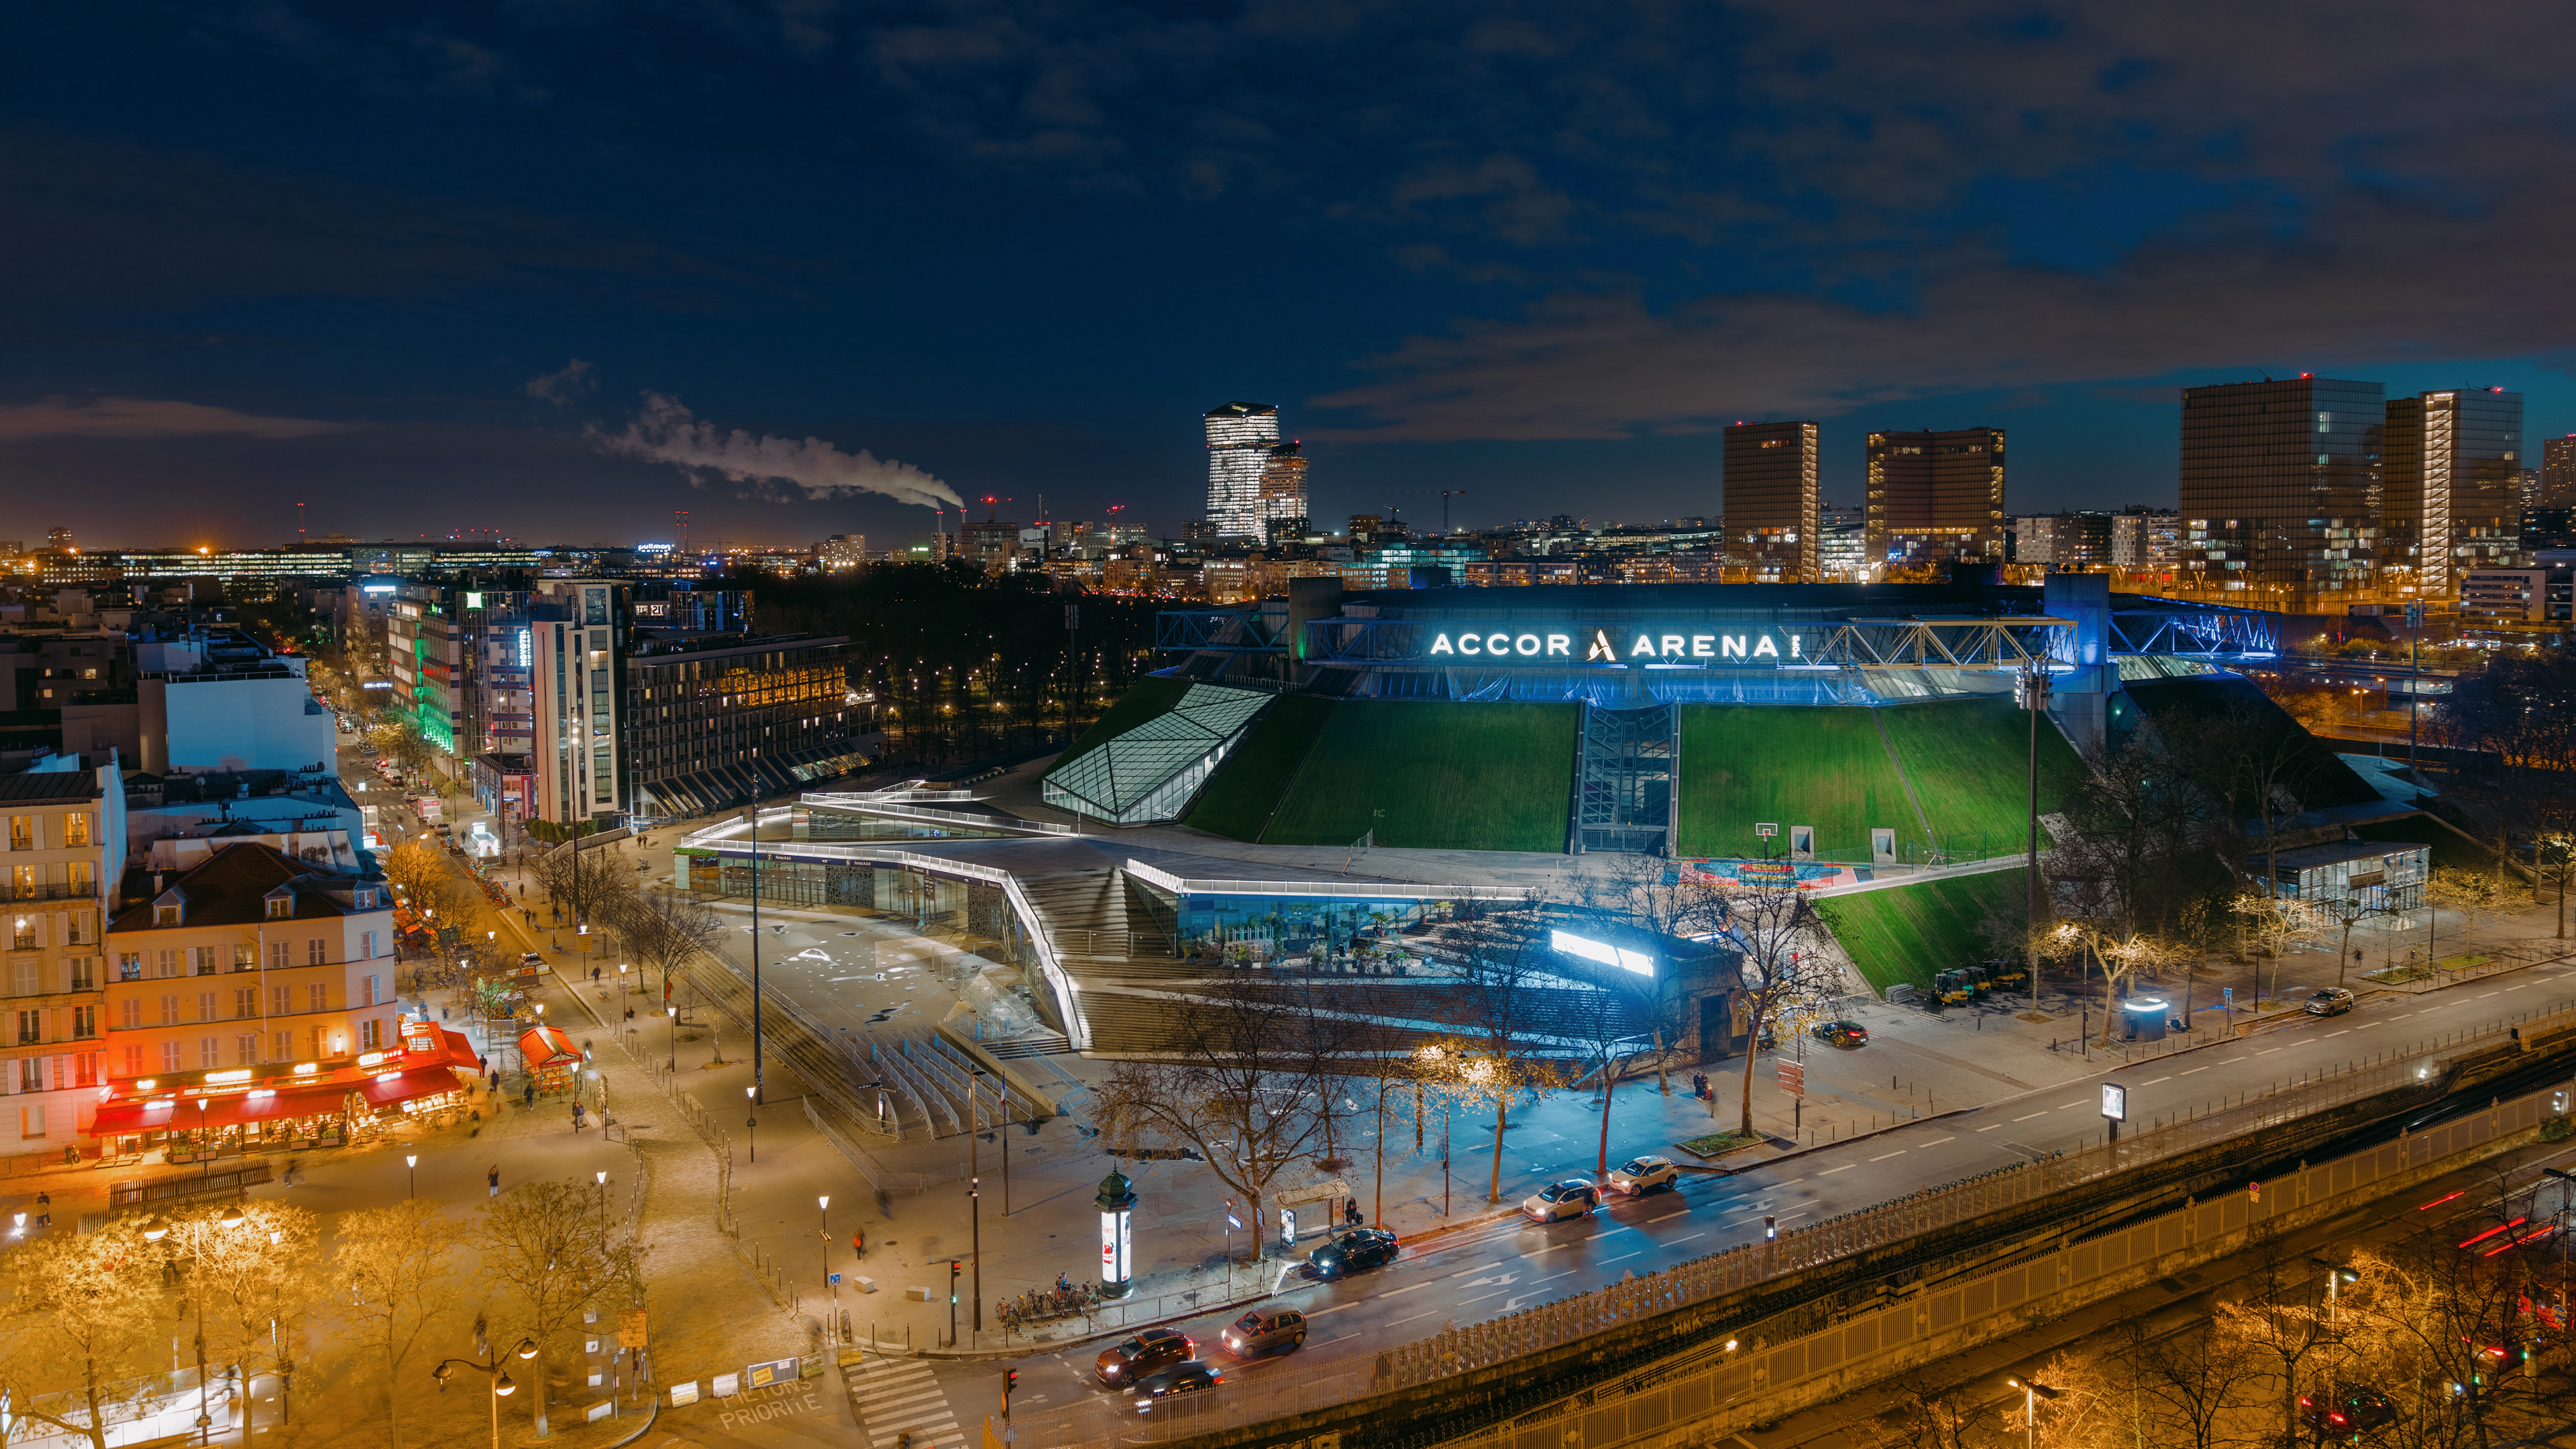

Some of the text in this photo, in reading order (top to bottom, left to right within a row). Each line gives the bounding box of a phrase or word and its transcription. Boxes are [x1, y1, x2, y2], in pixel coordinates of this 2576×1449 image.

[638, 543, 670, 551] pullman
[519, 629, 527, 667] NOVOTEL
[1430, 633, 1570, 655] ACCOR
[1631, 635, 1778, 657] ARENA
[1672, 1316, 1702, 1335] HNK
[755, 1370, 769, 1378] ROUTE
[755, 1375, 771, 1384] BARRÉE
